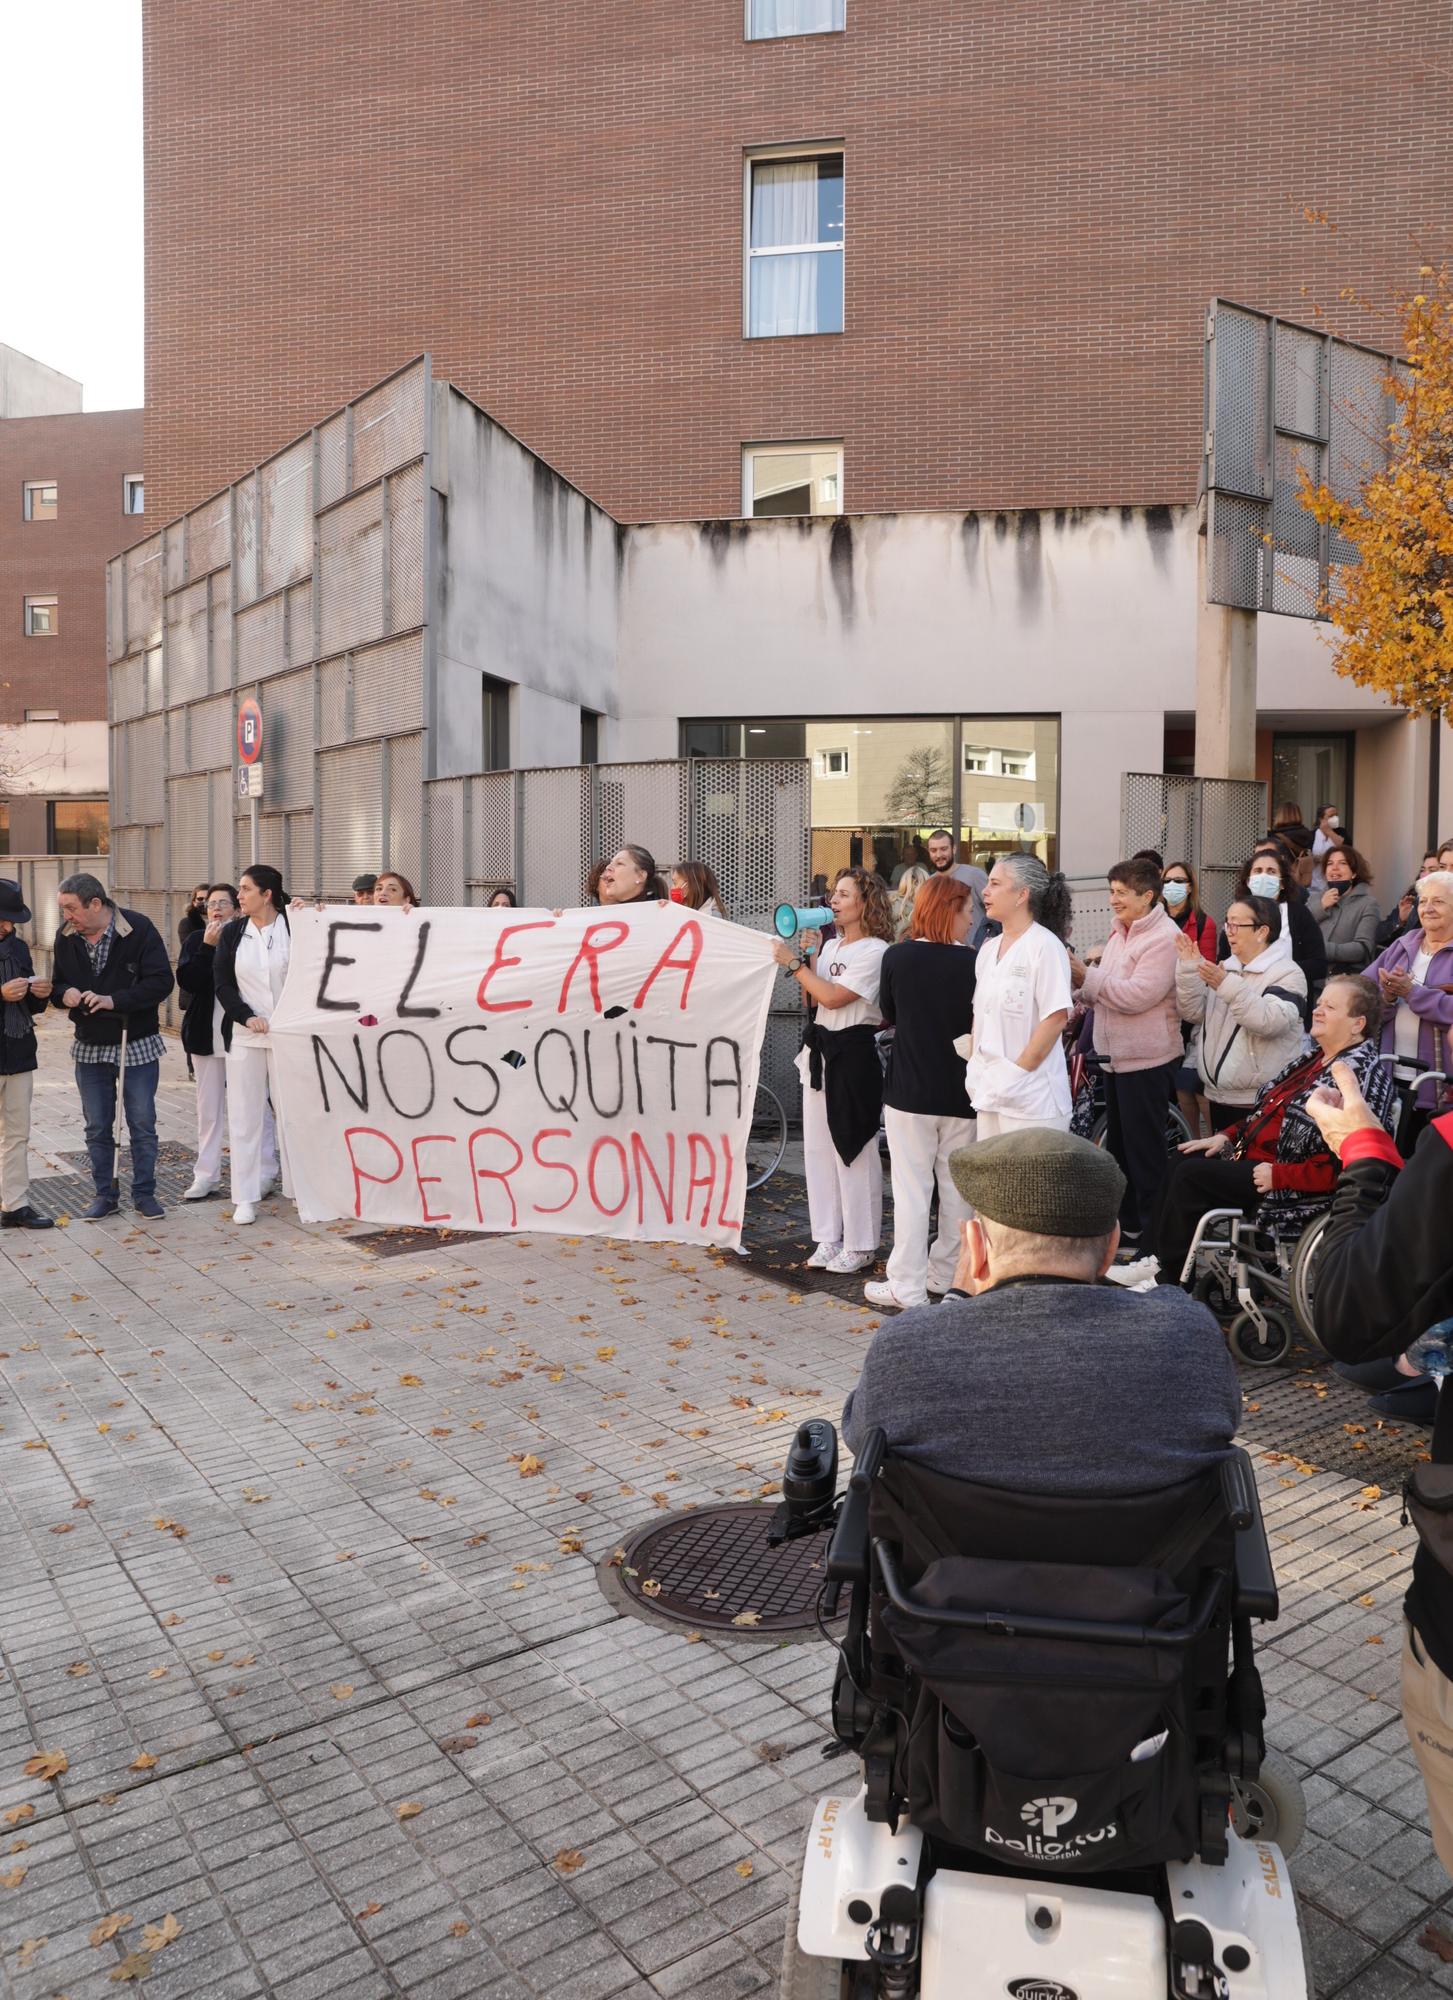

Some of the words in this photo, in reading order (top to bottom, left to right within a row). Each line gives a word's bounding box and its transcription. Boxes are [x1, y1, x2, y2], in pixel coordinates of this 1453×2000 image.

[316, 920, 441, 1019] EL
[476, 919, 704, 1014] ERA
[311, 1024, 501, 1119] NOS
[343, 1126, 741, 1230] PERSONAL
[1024, 1848, 1082, 1861] ORTOPEDIA
